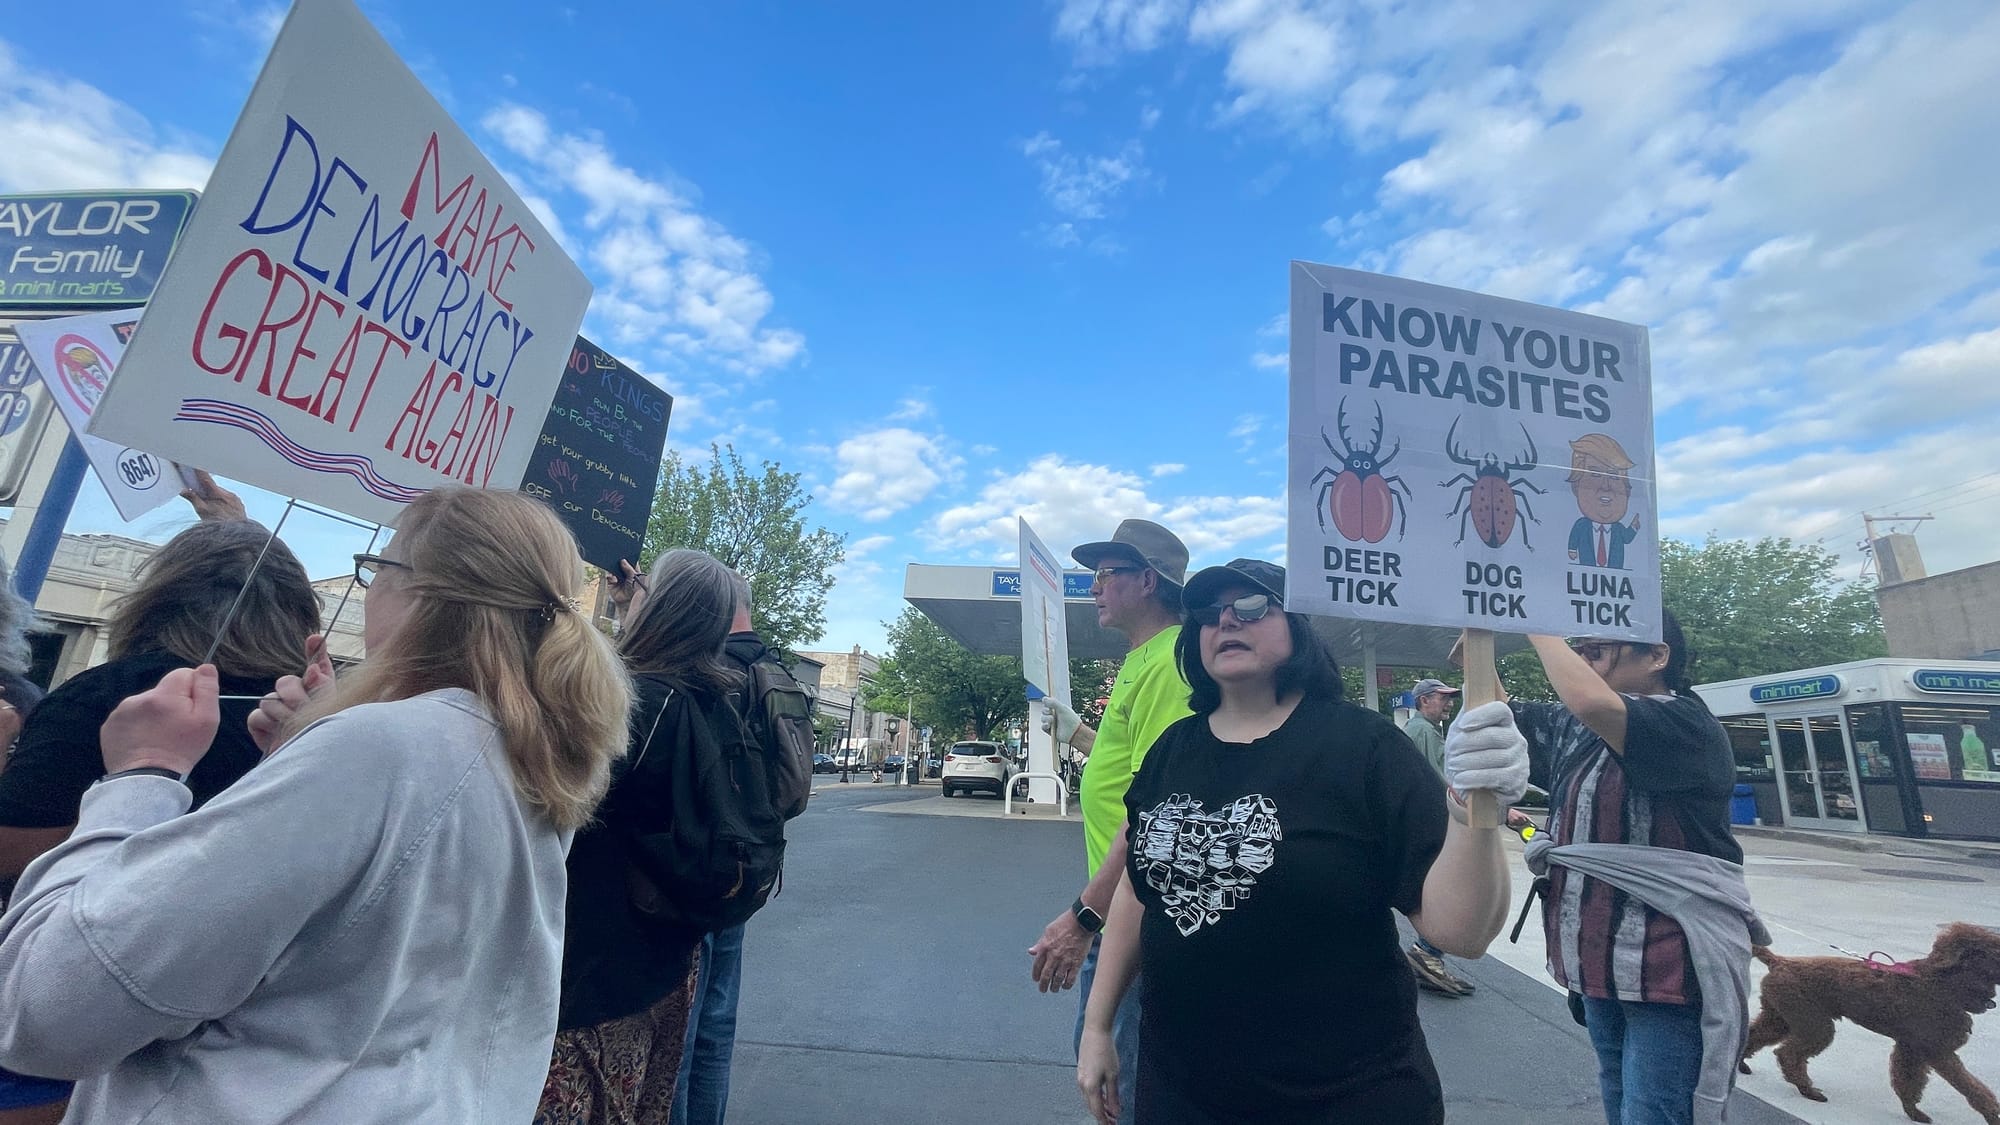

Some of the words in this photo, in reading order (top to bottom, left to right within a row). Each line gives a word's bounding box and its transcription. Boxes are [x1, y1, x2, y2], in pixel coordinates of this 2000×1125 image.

[400, 131, 535, 312] MAKE
[239, 114, 533, 399] DEMOCRACY
[59, 280, 124, 295] marts
[192, 248, 411, 432] GREAT
[1322, 292, 1481, 356] KNOW
[1492, 321, 1624, 383] YOUR
[601, 369, 663, 422] KINGS
[1339, 342, 1611, 424] PARASITES
[594, 397, 610, 413] RUN
[384, 359, 514, 489] AGAIN
[569, 408, 593, 432] FOR
[597, 427, 615, 442] THE
[586, 406, 633, 440] PEOPLE
[541, 433, 557, 447] get
[562, 445, 582, 460] your
[585, 459, 614, 480] grubby
[526, 482, 552, 498] OFF
[592, 508, 641, 541] DEMOCRACY
[1323, 545, 1402, 577] DEER
[1466, 560, 1523, 589] DOG
[996, 576, 1020, 584] TAYL
[1326, 576, 1399, 607] TICK
[1566, 571, 1635, 600] LUNA
[1462, 589, 1527, 619] TICK
[1571, 599, 1632, 628] TICK
[1760, 687, 1786, 699] mini
[1789, 681, 1821, 696] mart
[1925, 676, 1965, 687] mini
